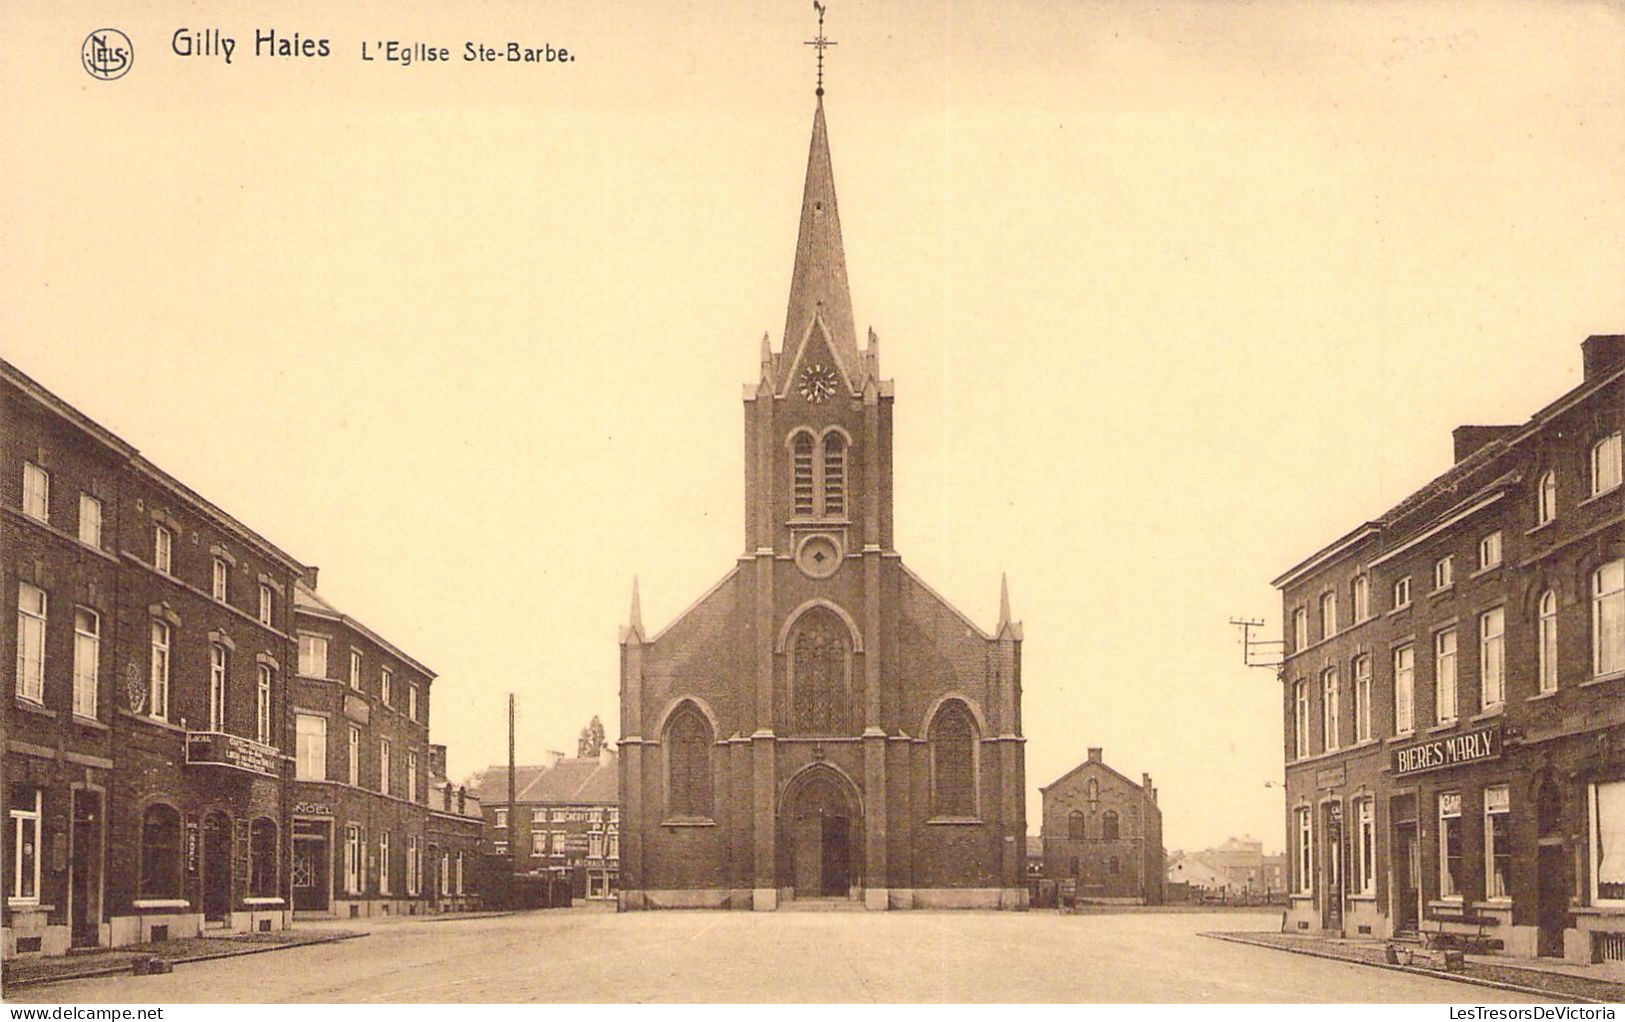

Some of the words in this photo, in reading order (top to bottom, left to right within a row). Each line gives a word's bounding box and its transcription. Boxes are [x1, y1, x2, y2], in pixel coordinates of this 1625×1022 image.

[1399, 742, 1443, 773] BIERES
[1446, 731, 1493, 764] MARLY
[292, 804, 334, 815] NOEL
